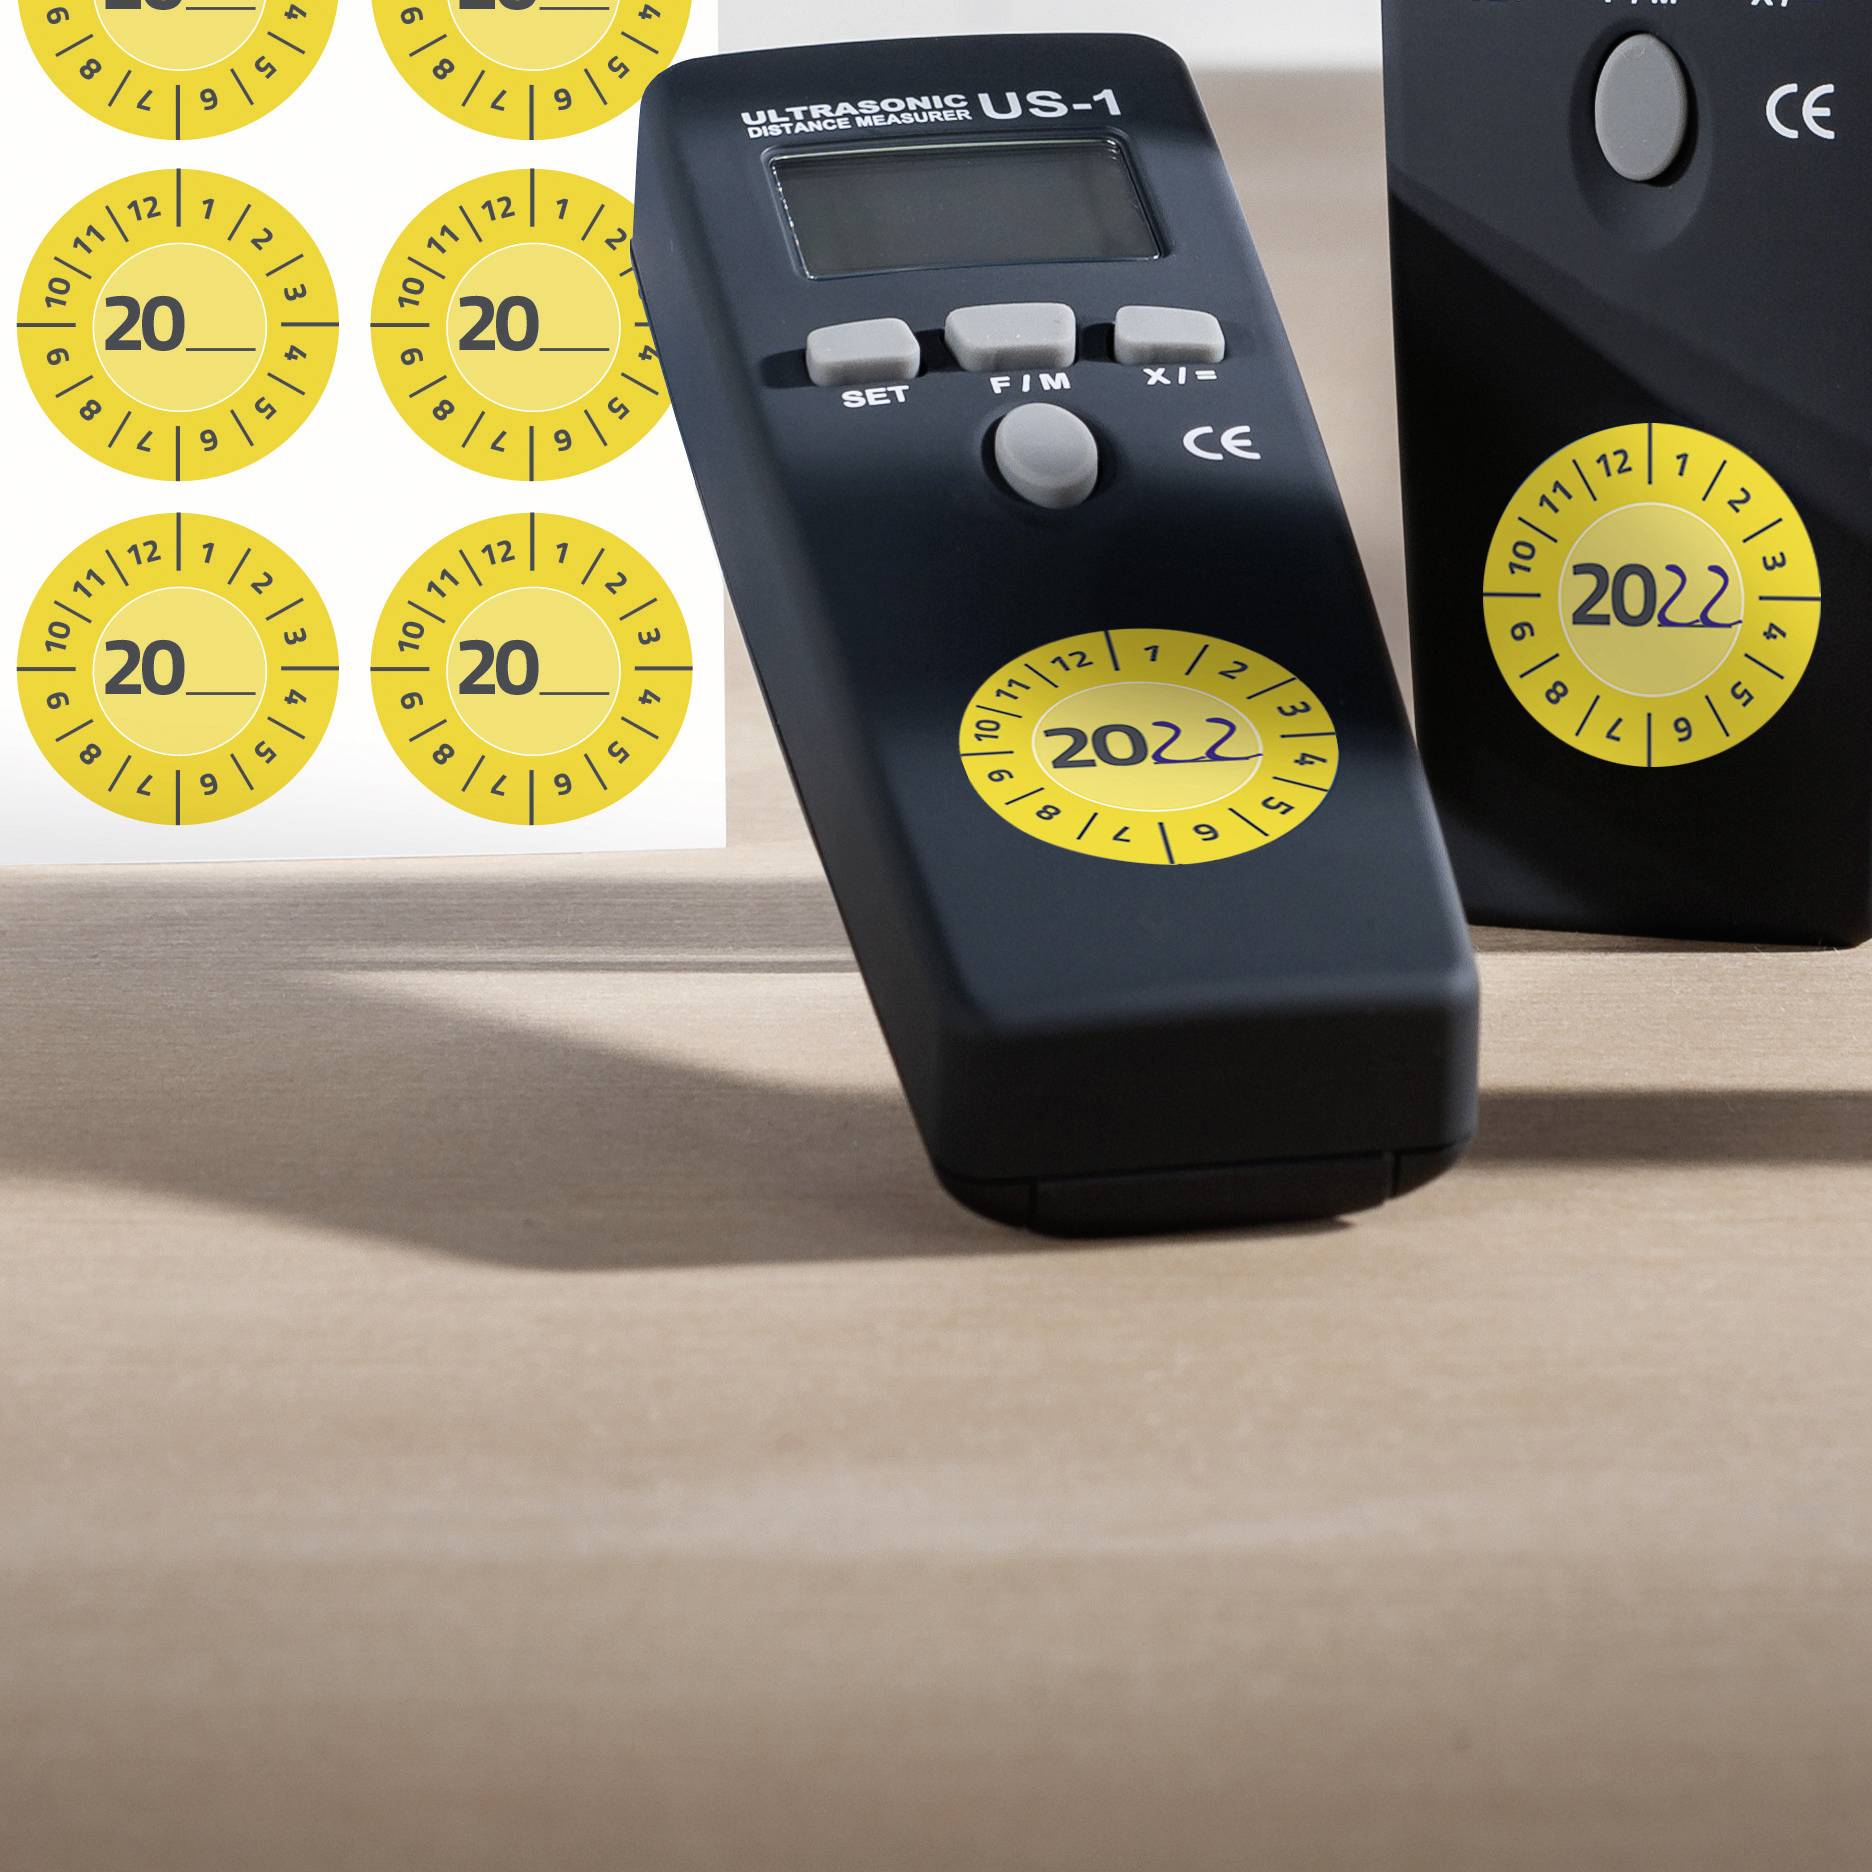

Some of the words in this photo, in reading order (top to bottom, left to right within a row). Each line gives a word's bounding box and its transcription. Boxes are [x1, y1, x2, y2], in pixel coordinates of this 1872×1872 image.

[741, 93, 969, 127] ULTRASONIC
[977, 87, 1122, 121] US-1
[747, 116, 851, 140] DISTANCE
[855, 108, 974, 130] MEASURER
[840, 383, 910, 409] SET
[1596, 449, 1633, 477] 12
[1676, 453, 1689, 477] 1
[1538, 480, 1573, 514] 11
[1727, 487, 1751, 513] 2
[481, 540, 516, 565] 12
[556, 542, 569, 564] 1
[1508, 540, 1536, 575] 10
[1762, 552, 1786, 571] 3
[427, 568, 460, 598] 11
[604, 571, 627, 595] 2
[1572, 562, 1743, 629] 2022
[397, 621, 425, 652] 10
[637, 627, 661, 645] 3
[1510, 621, 1535, 642] 9
[1762, 622, 1787, 640] 4
[1050, 649, 1094, 673] 12
[1143, 644, 1160, 663] 1
[1218, 659, 1249, 681] 2
[638, 689, 661, 705] 4
[995, 677, 1032, 702] 11
[1545, 680, 1569, 705] 8
[1730, 681, 1754, 708] 5
[1276, 700, 1311, 718] 3
[974, 718, 1000, 743] 10
[1605, 717, 1623, 742] 7
[1673, 716, 1692, 743] 6
[607, 740, 630, 764] 5
[1042, 716, 1264, 770] 2022
[1293, 752, 1327, 767] 4
[987, 768, 1014, 783] 9
[1035, 803, 1062, 821] 8
[1261, 795, 1295, 816] 5
[1112, 825, 1131, 843] 7
[1193, 823, 1219, 842] 6
